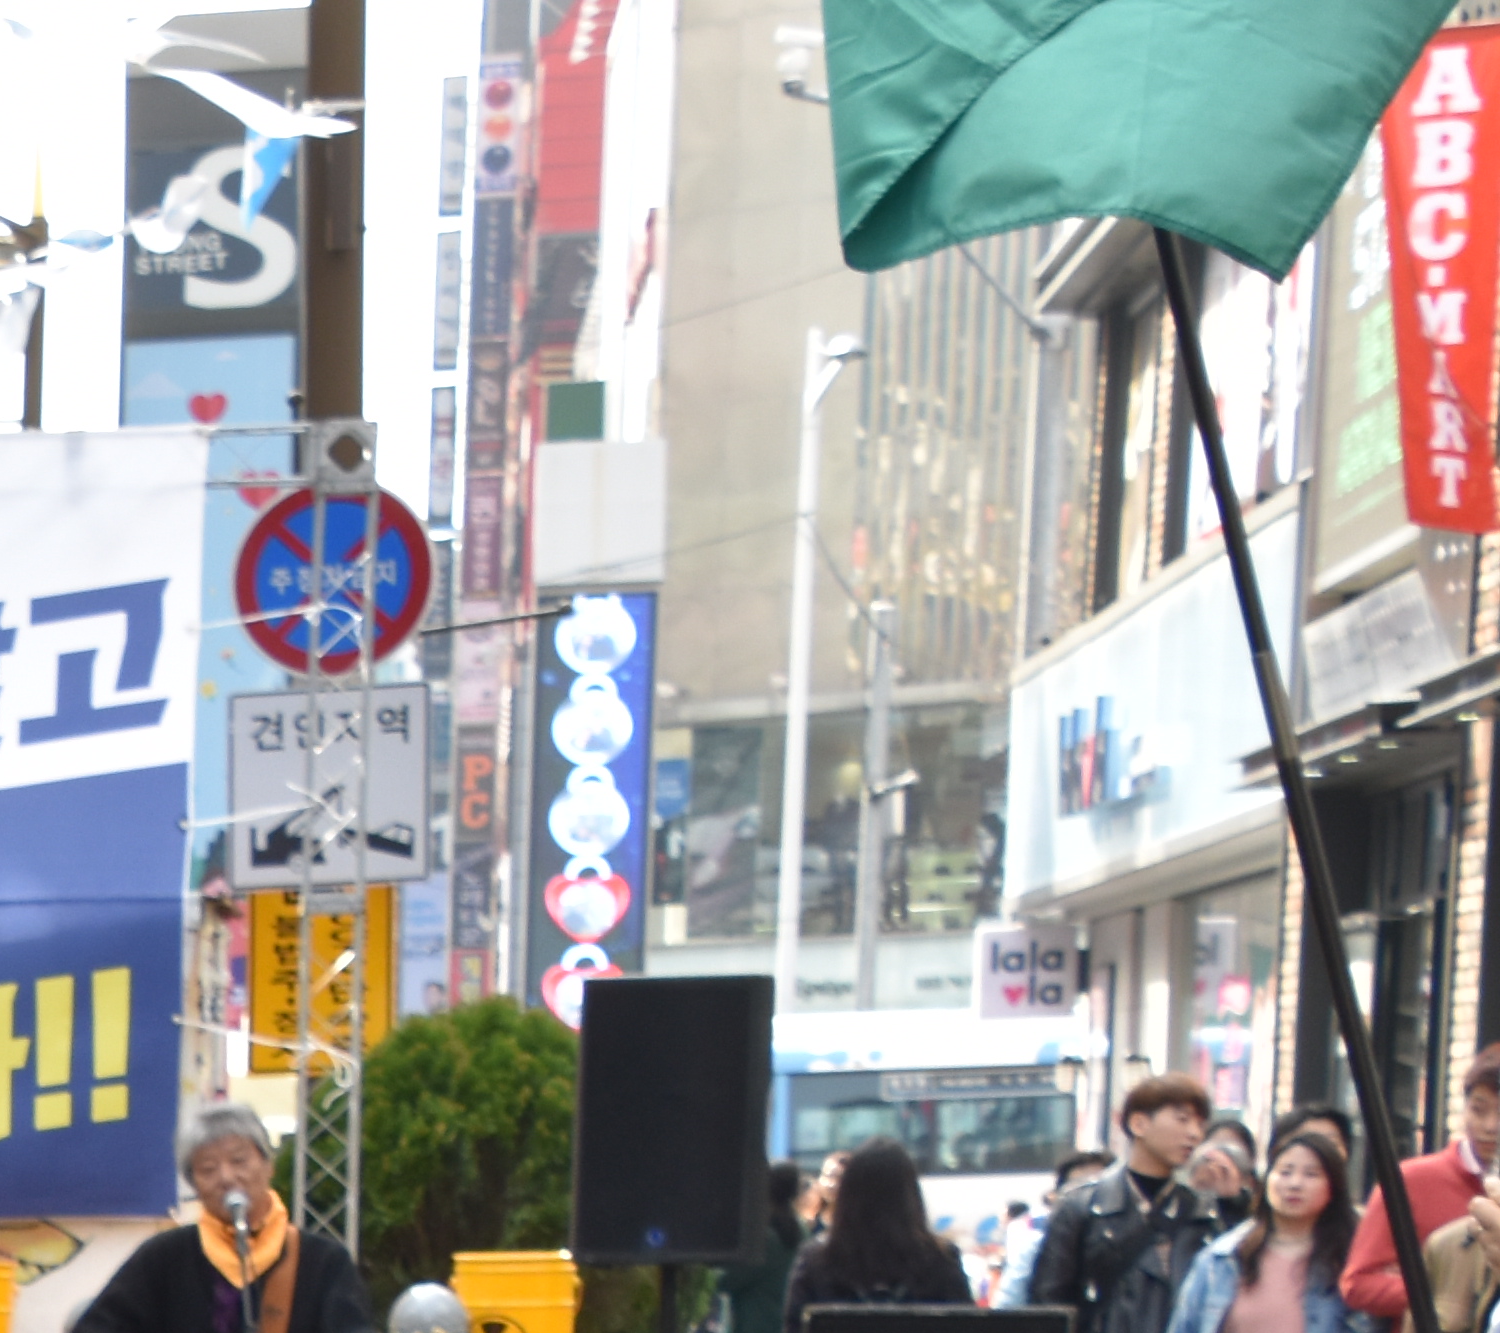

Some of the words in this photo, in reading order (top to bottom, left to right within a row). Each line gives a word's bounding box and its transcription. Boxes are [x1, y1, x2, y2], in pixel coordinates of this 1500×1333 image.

[134, 252, 229, 277] STREET
[460, 752, 494, 829] PC
[990, 937, 1066, 975] lala
